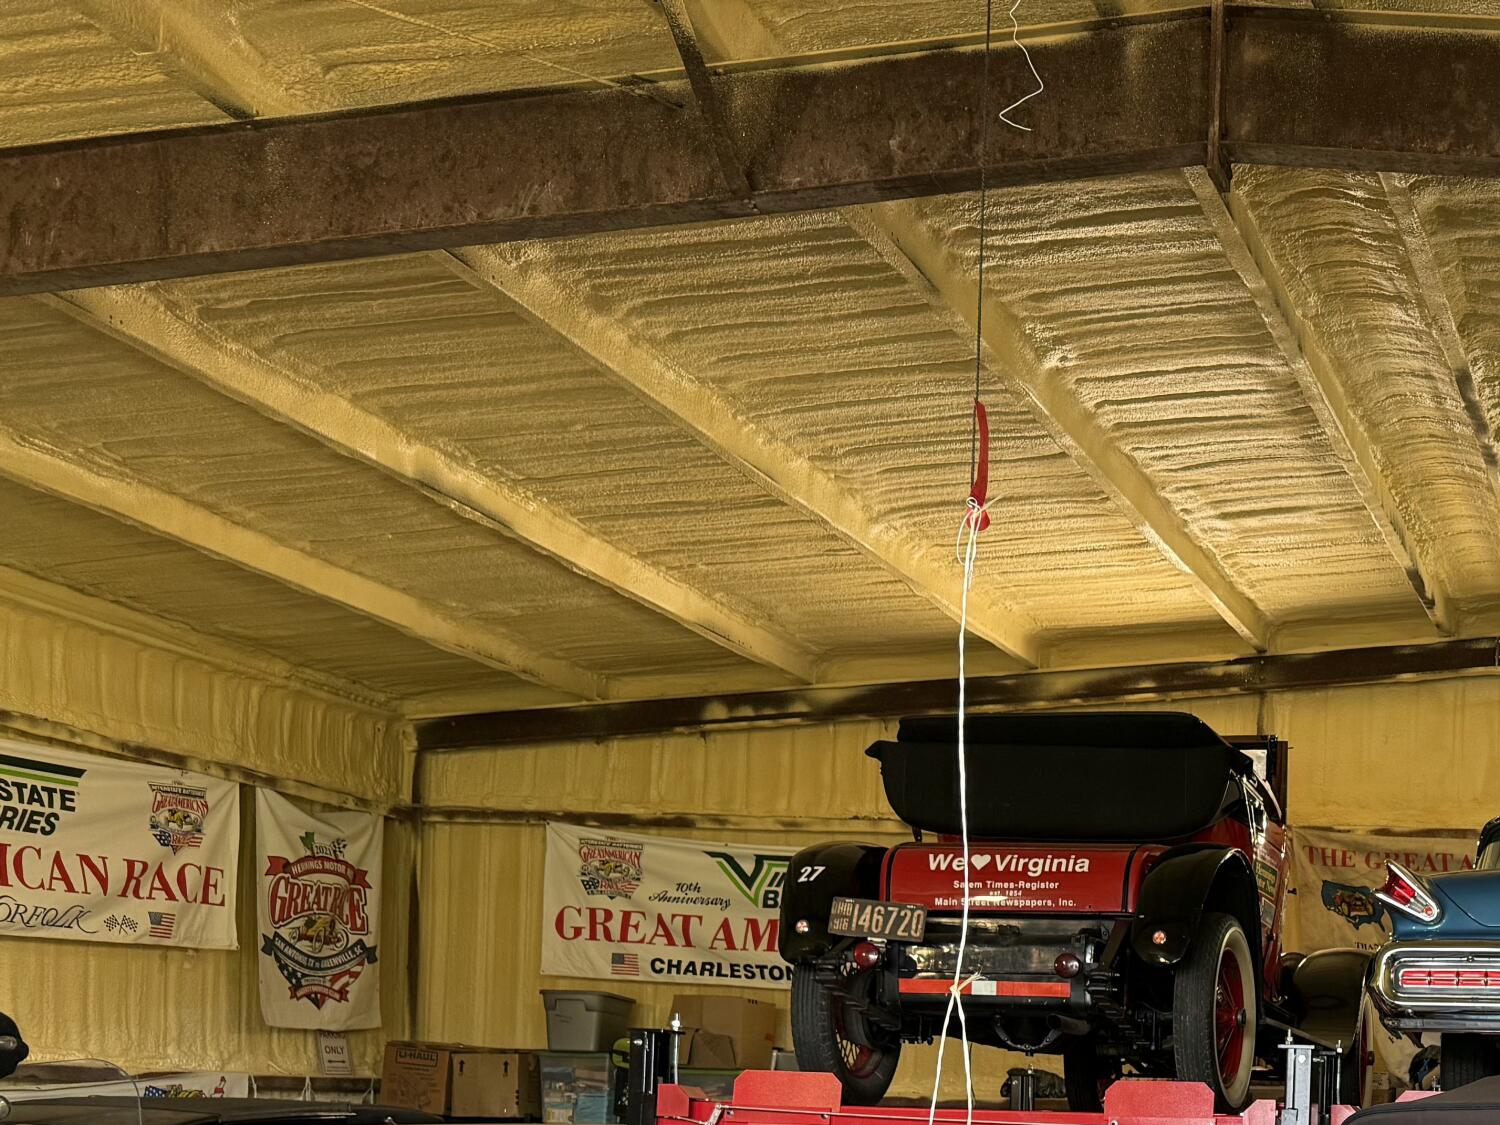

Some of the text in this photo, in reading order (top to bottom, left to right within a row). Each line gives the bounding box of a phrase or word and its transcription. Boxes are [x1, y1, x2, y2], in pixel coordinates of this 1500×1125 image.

[928, 853, 1089, 877] We Virginia
[1303, 846, 1356, 868] THE
[117, 858, 226, 907] RACE
[798, 866, 825, 883] 27
[675, 882, 701, 893] 10th
[953, 880, 1059, 890] Saem Times-Register
[648, 890, 732, 911] Anniversary
[934, 897, 1077, 909] Main Sreet Newspapers, Inc.
[555, 905, 703, 948] GREAT
[851, 903, 925, 937] 146720
[324, 1044, 344, 1055] ONLY
[398, 1049, 436, 1062] U-HAUL
